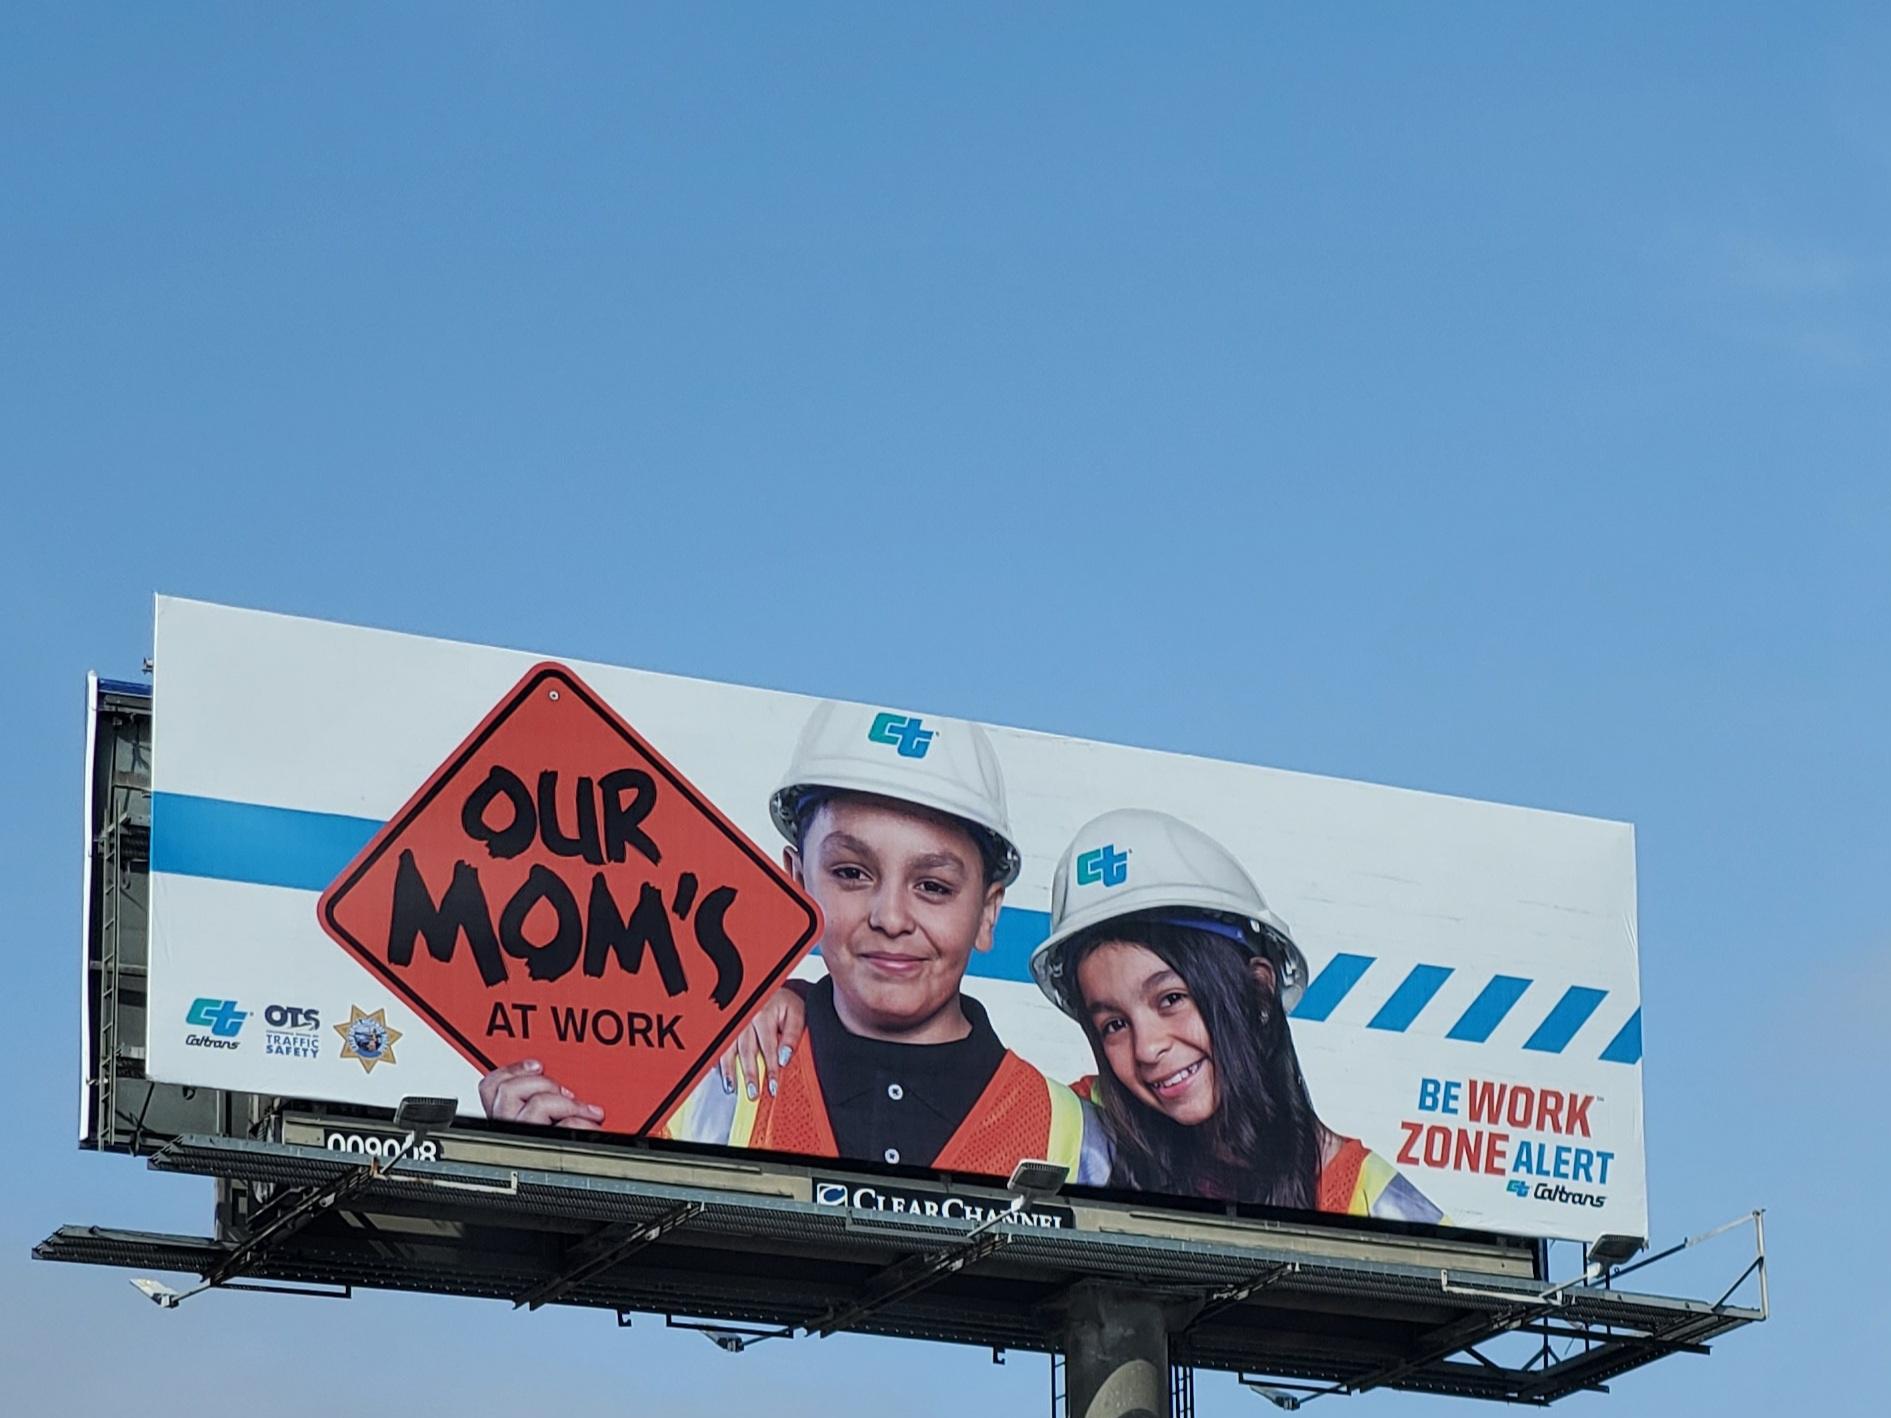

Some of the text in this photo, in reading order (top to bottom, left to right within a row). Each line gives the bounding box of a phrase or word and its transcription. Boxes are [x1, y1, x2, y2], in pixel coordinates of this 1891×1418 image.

[460, 764, 662, 867] OUR
[387, 848, 744, 1011] MOM'S
[264, 1004, 320, 1031] OTS
[485, 1001, 686, 1051] AT WORK
[185, 1033, 240, 1050] Caltrans
[266, 1034, 319, 1049] TRAFFIC
[266, 1044, 319, 1059] SAFETY
[1418, 1077, 1462, 1115] BE
[327, 1133, 438, 1163] 00908
[1396, 1120, 1615, 1185] ZONE ALERT
[1533, 1182, 1607, 1209] Caltrans
